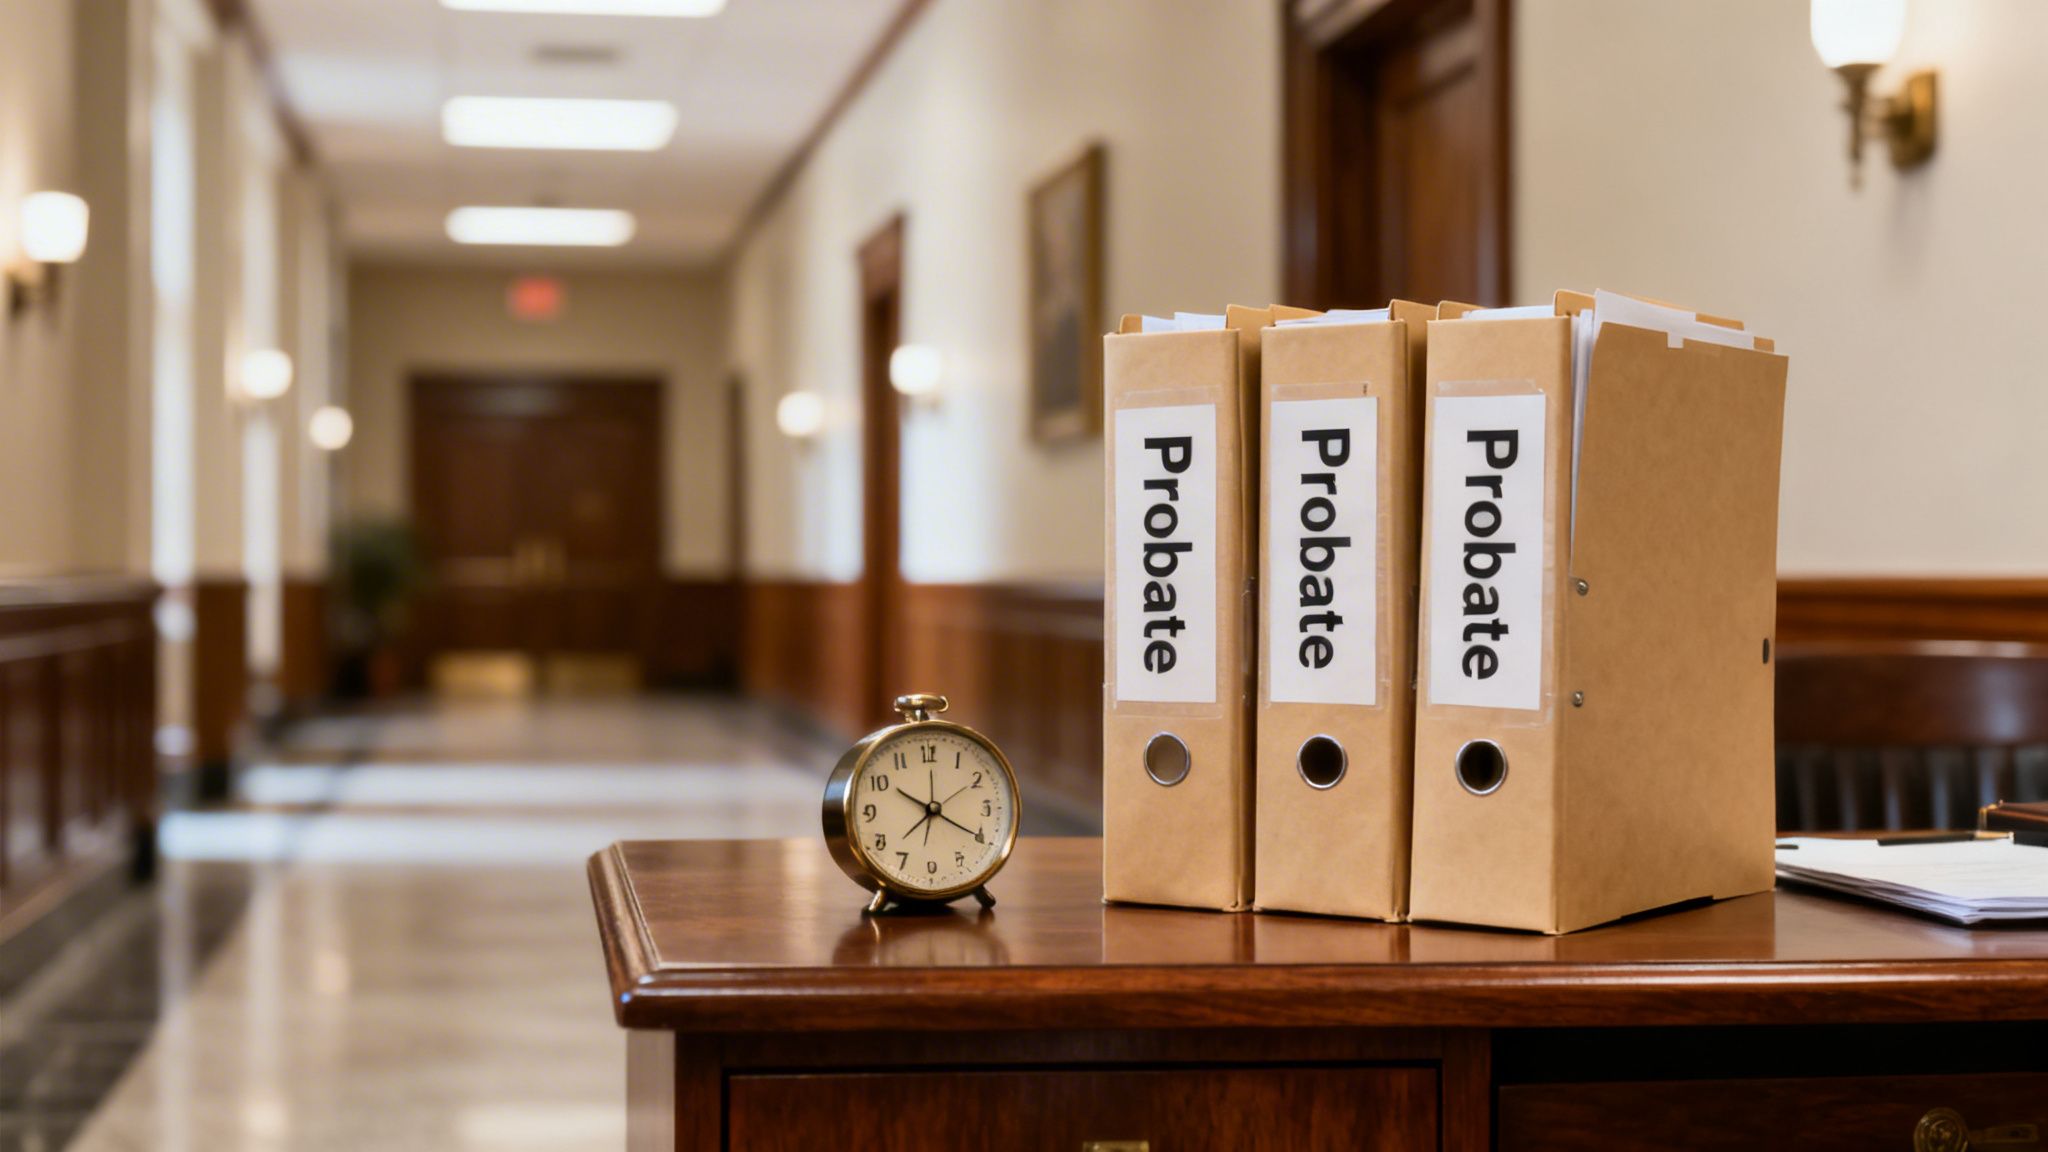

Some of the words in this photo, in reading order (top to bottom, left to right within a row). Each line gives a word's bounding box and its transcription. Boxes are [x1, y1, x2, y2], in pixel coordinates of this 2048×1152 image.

[1143, 437, 1193, 674] Probate
[1298, 428, 1351, 669] Probate
[1461, 429, 1519, 680] Probate
[894, 753, 907, 770] 11
[871, 775, 889, 791] 10
[970, 772, 982, 789] 2
[863, 804, 877, 822] 9
[896, 852, 908, 870] 7
